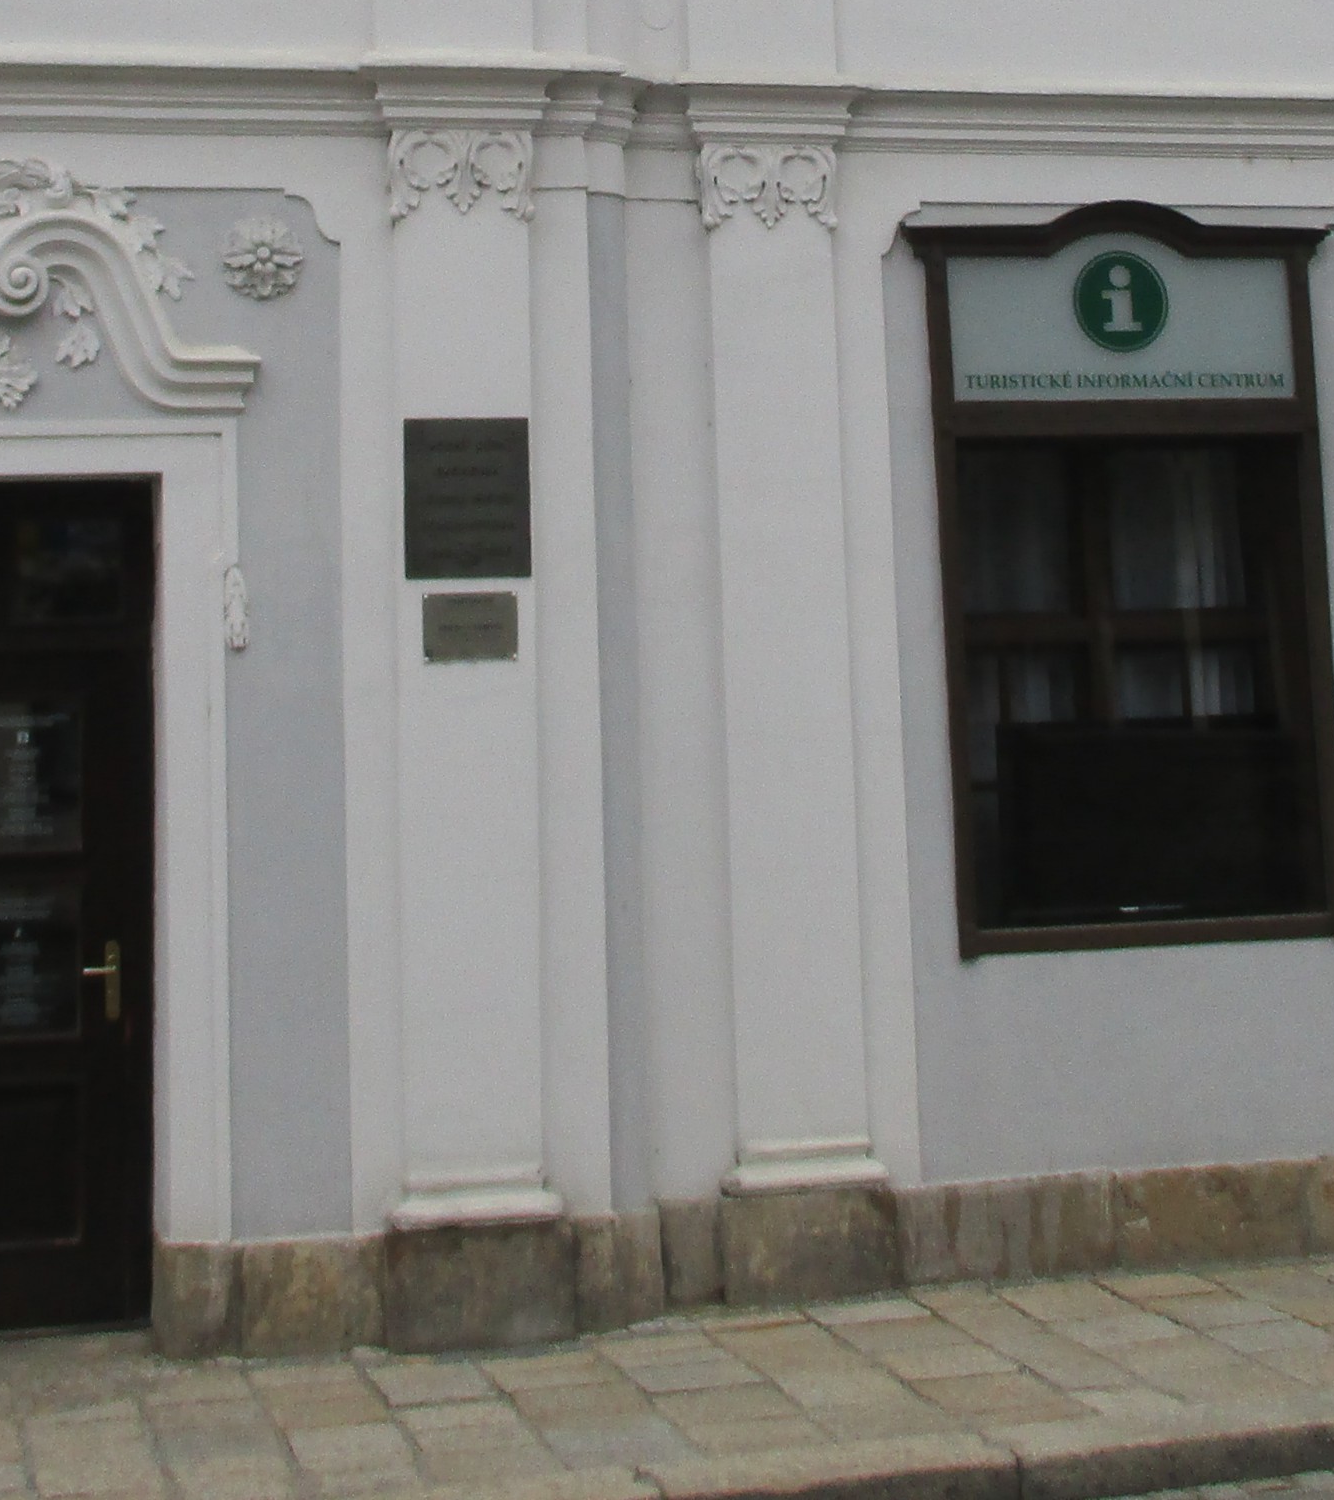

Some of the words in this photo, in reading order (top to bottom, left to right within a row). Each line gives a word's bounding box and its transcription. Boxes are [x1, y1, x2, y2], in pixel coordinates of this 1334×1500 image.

[965, 371, 1071, 390] TURISTICKÉ
[1077, 370, 1193, 389] INFORMAČNÍ
[1198, 372, 1285, 389] CENTRUM
